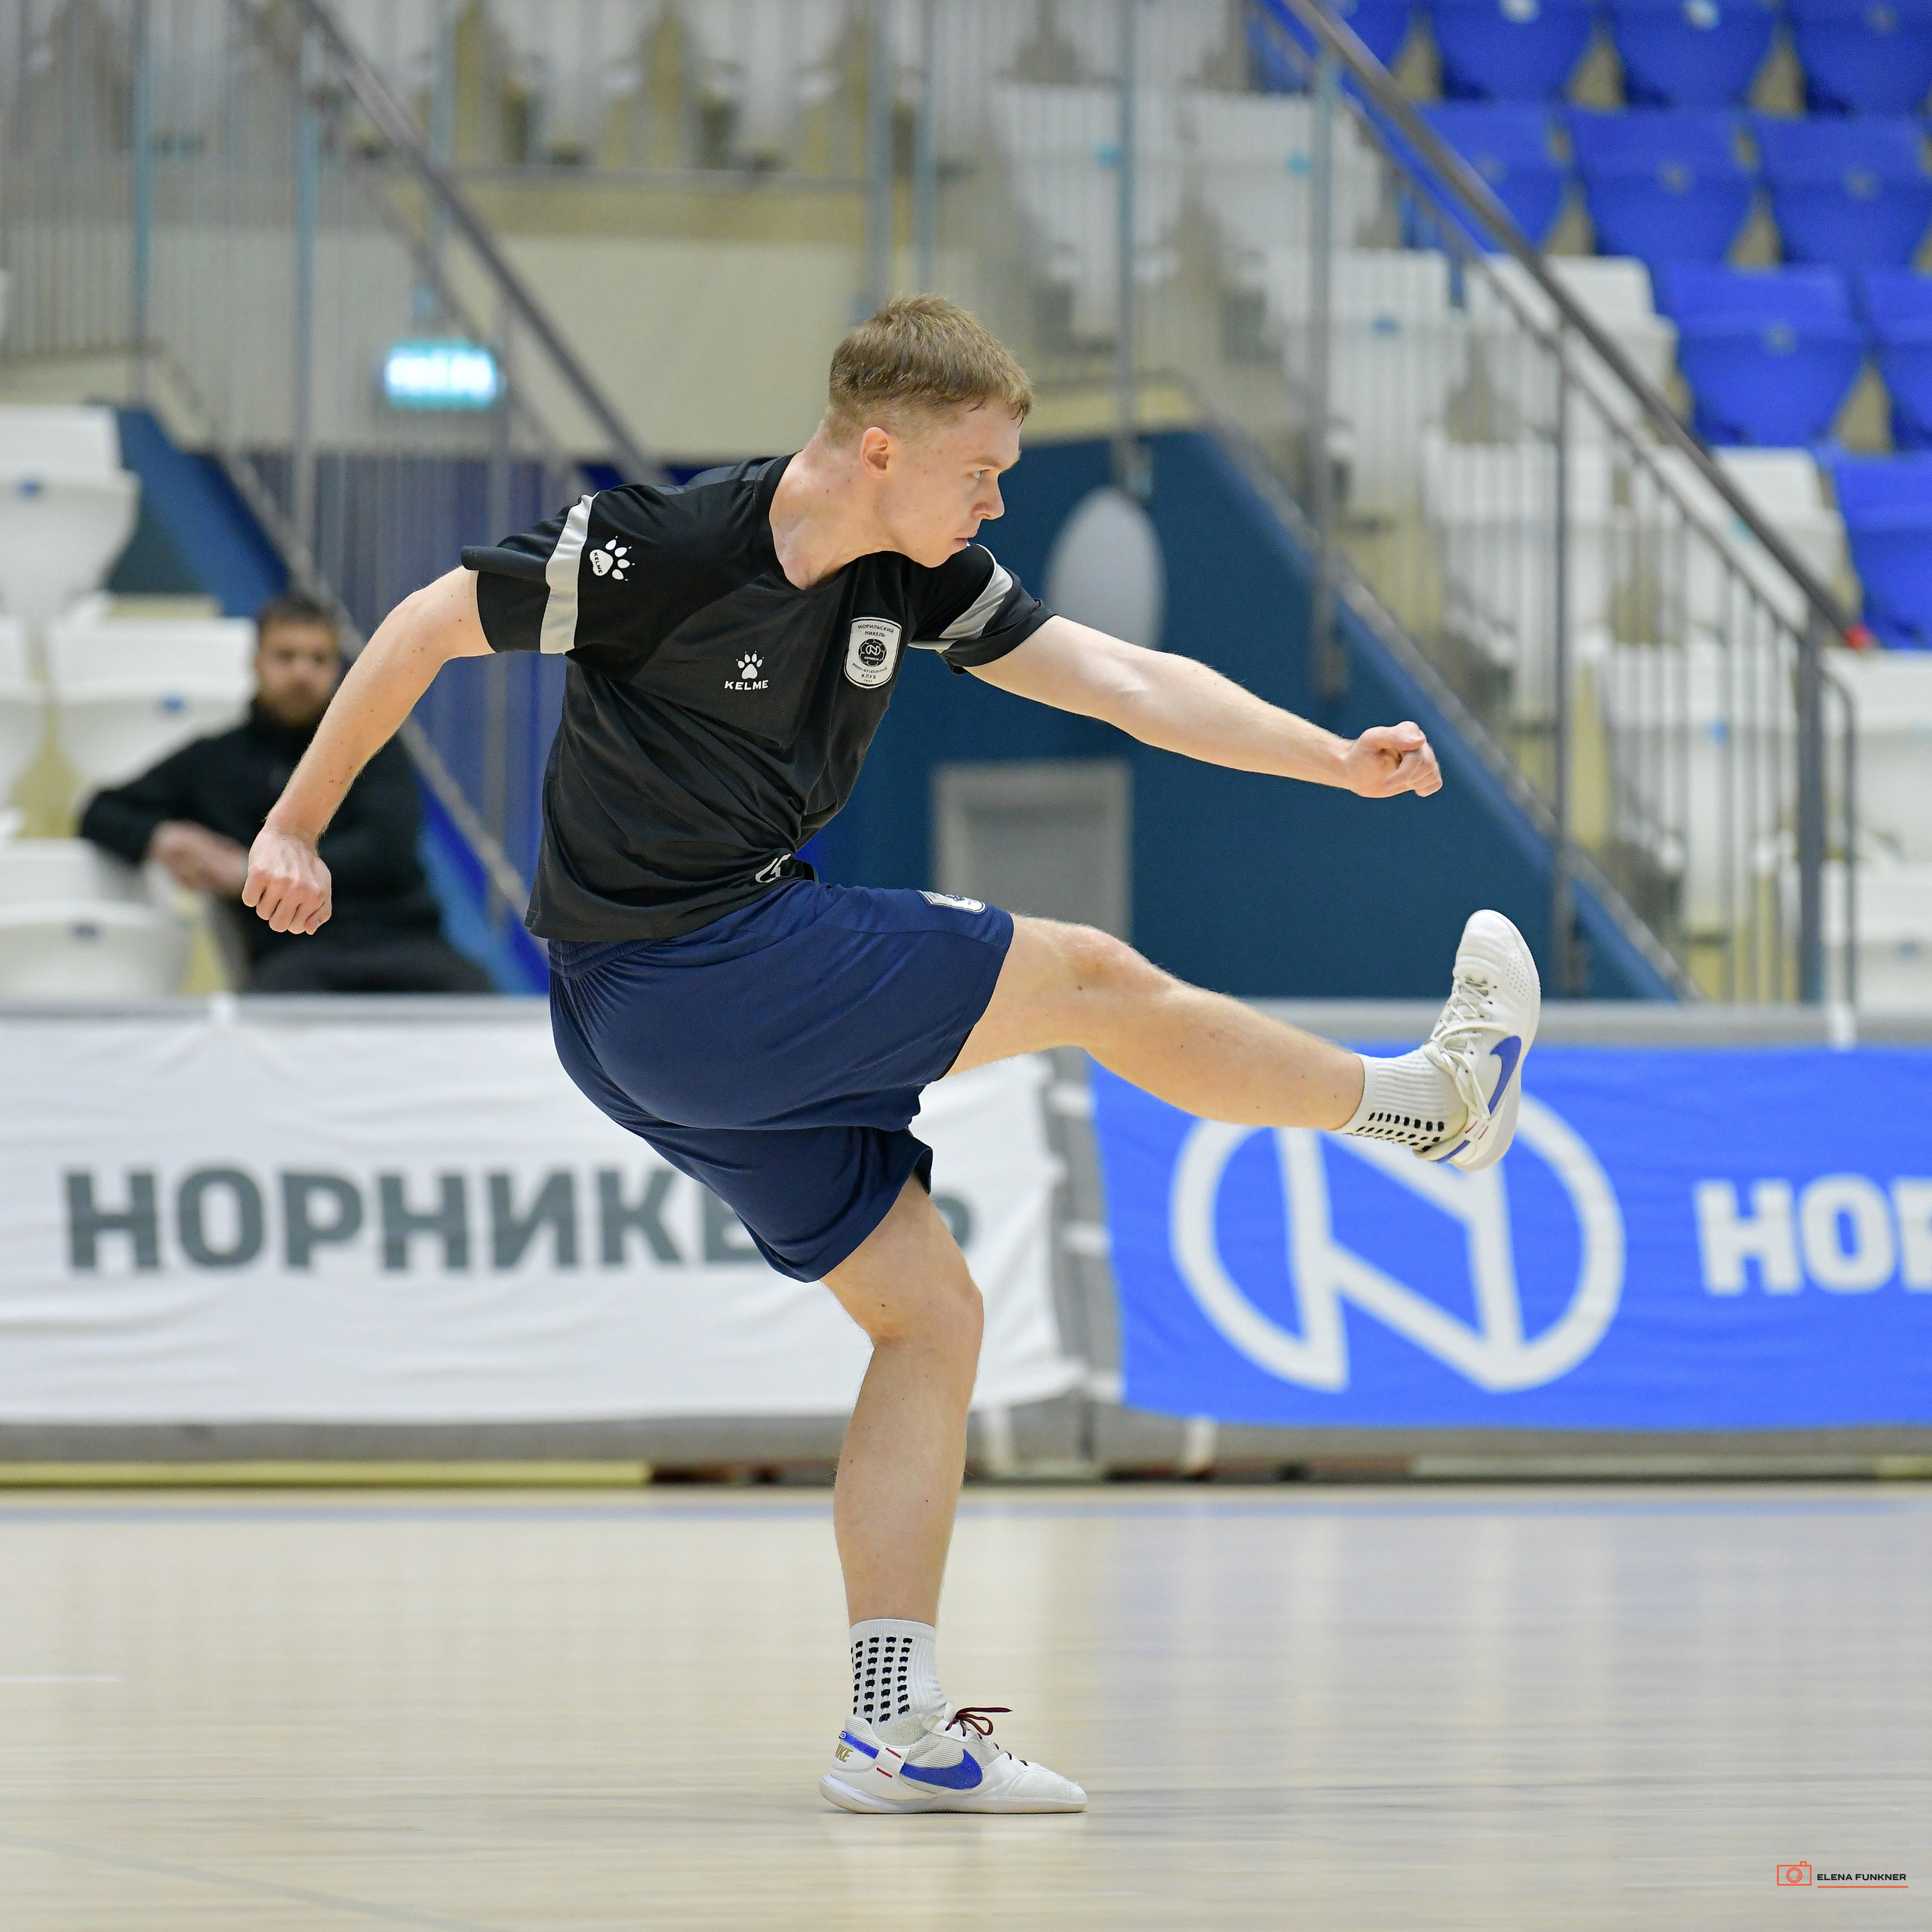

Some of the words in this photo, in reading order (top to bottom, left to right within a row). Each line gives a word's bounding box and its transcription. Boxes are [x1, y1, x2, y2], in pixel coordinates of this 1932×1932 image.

[593, 552, 603, 574] KELME
[857, 624, 894, 633] НОРИЛЬСКИЙ
[724, 679, 769, 691] KELME
[65, 1164, 974, 1274] НОРНИКЕ
[835, 1743, 854, 1763] IKE
